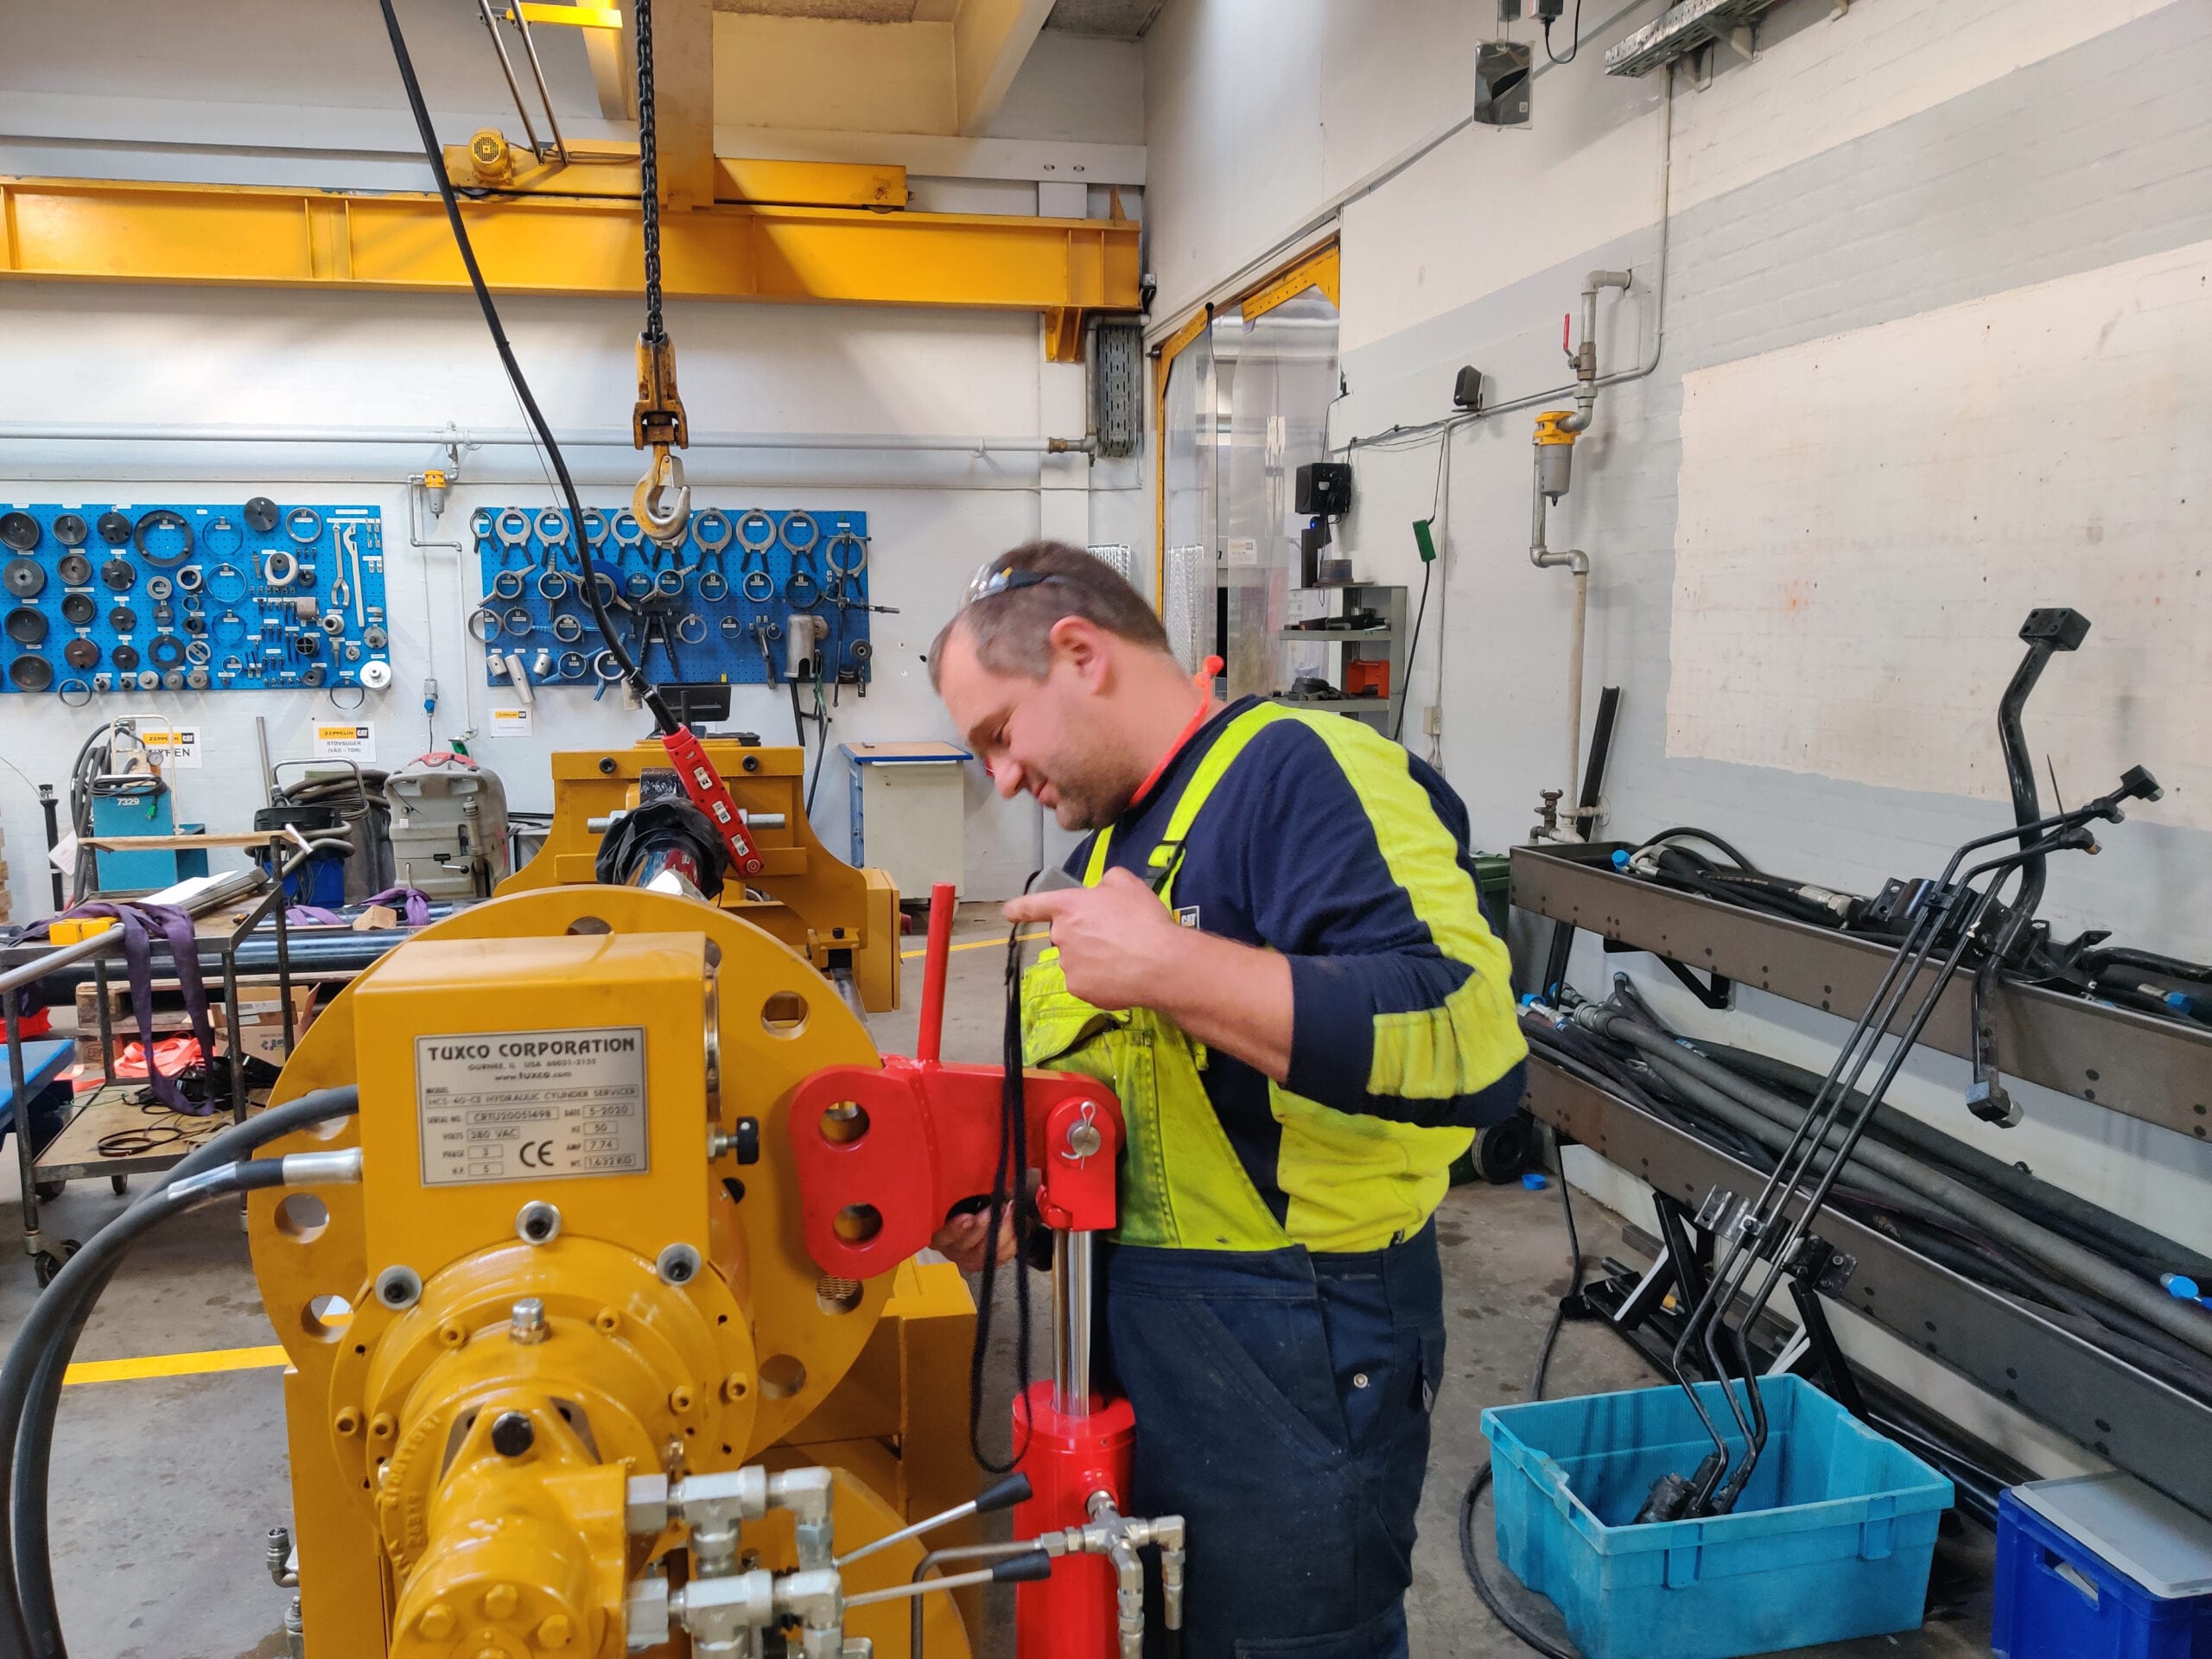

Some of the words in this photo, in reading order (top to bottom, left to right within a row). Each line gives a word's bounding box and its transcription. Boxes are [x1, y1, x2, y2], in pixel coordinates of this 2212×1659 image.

[117, 798, 140, 806] 7329
[1181, 913, 1197, 927] CAT
[428, 1044, 490, 1061] TUXCO
[499, 1037, 635, 1058] CORPORATION
[524, 1060, 542, 1068] USA
[494, 1071, 572, 1081] www.tuxco.com
[486, 1092, 540, 1103] HYDRAULIC
[544, 1090, 588, 1101] CYLINDER
[594, 1087, 636, 1098] SERVICER
[565, 1109, 581, 1118] DATE
[589, 1105, 628, 1116] 5-2020
[594, 1123, 608, 1133] 50
[495, 1128, 518, 1139] VAC
